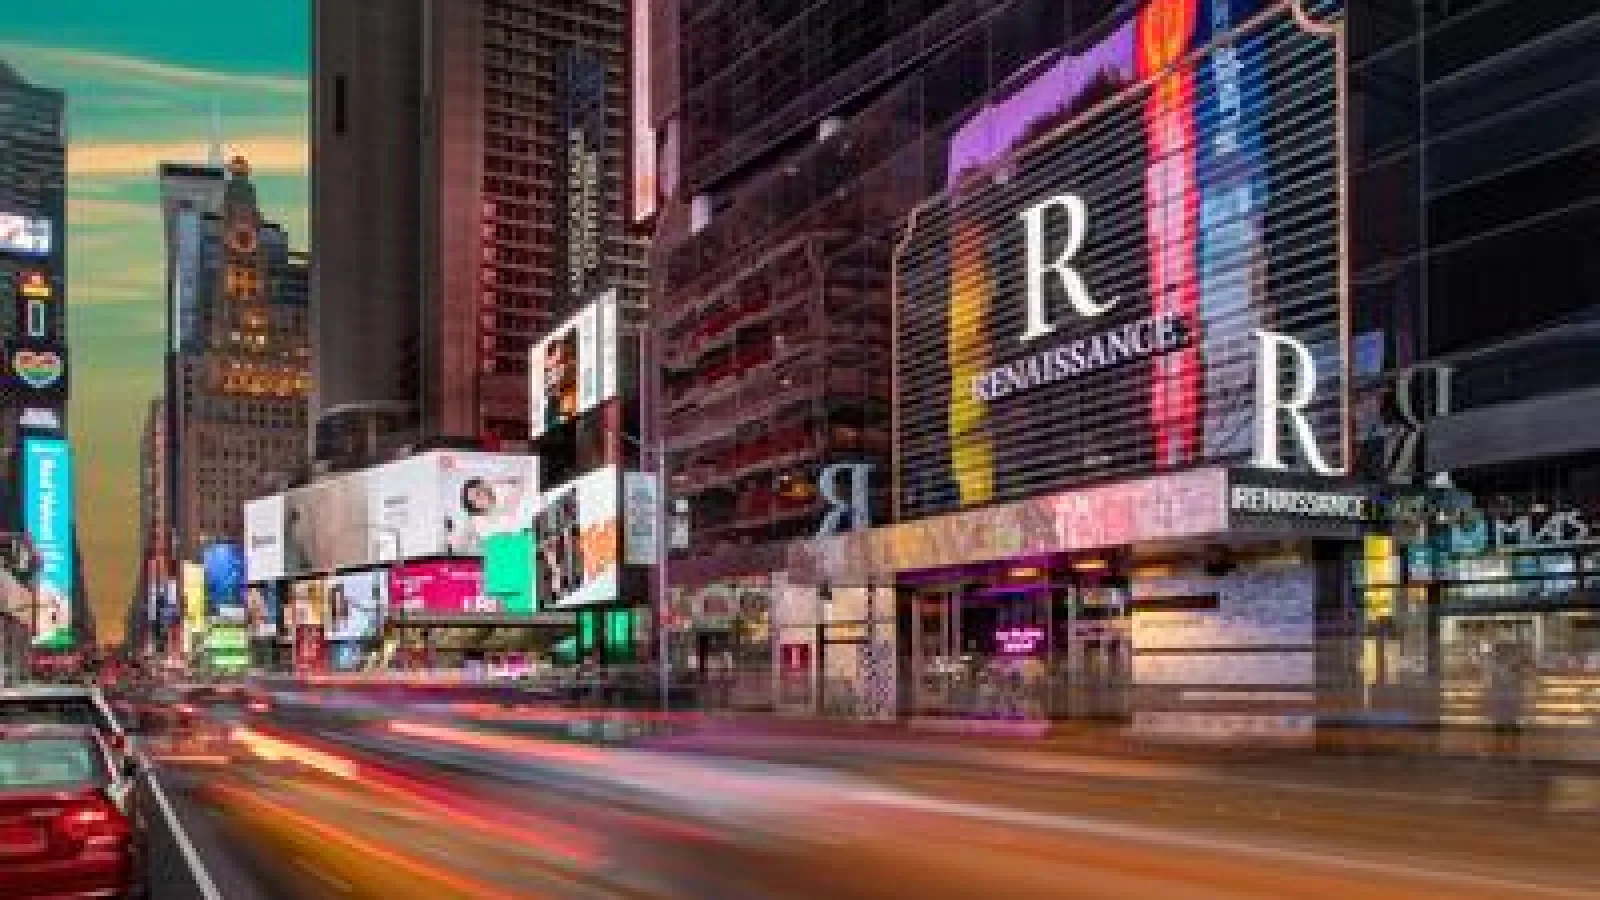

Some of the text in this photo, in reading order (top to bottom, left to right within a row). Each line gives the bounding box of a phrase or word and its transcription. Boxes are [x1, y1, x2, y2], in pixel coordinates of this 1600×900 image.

[1019, 193, 1119, 342] R
[973, 312, 1180, 402] RENAISSANCE
[1248, 329, 1346, 476] R
